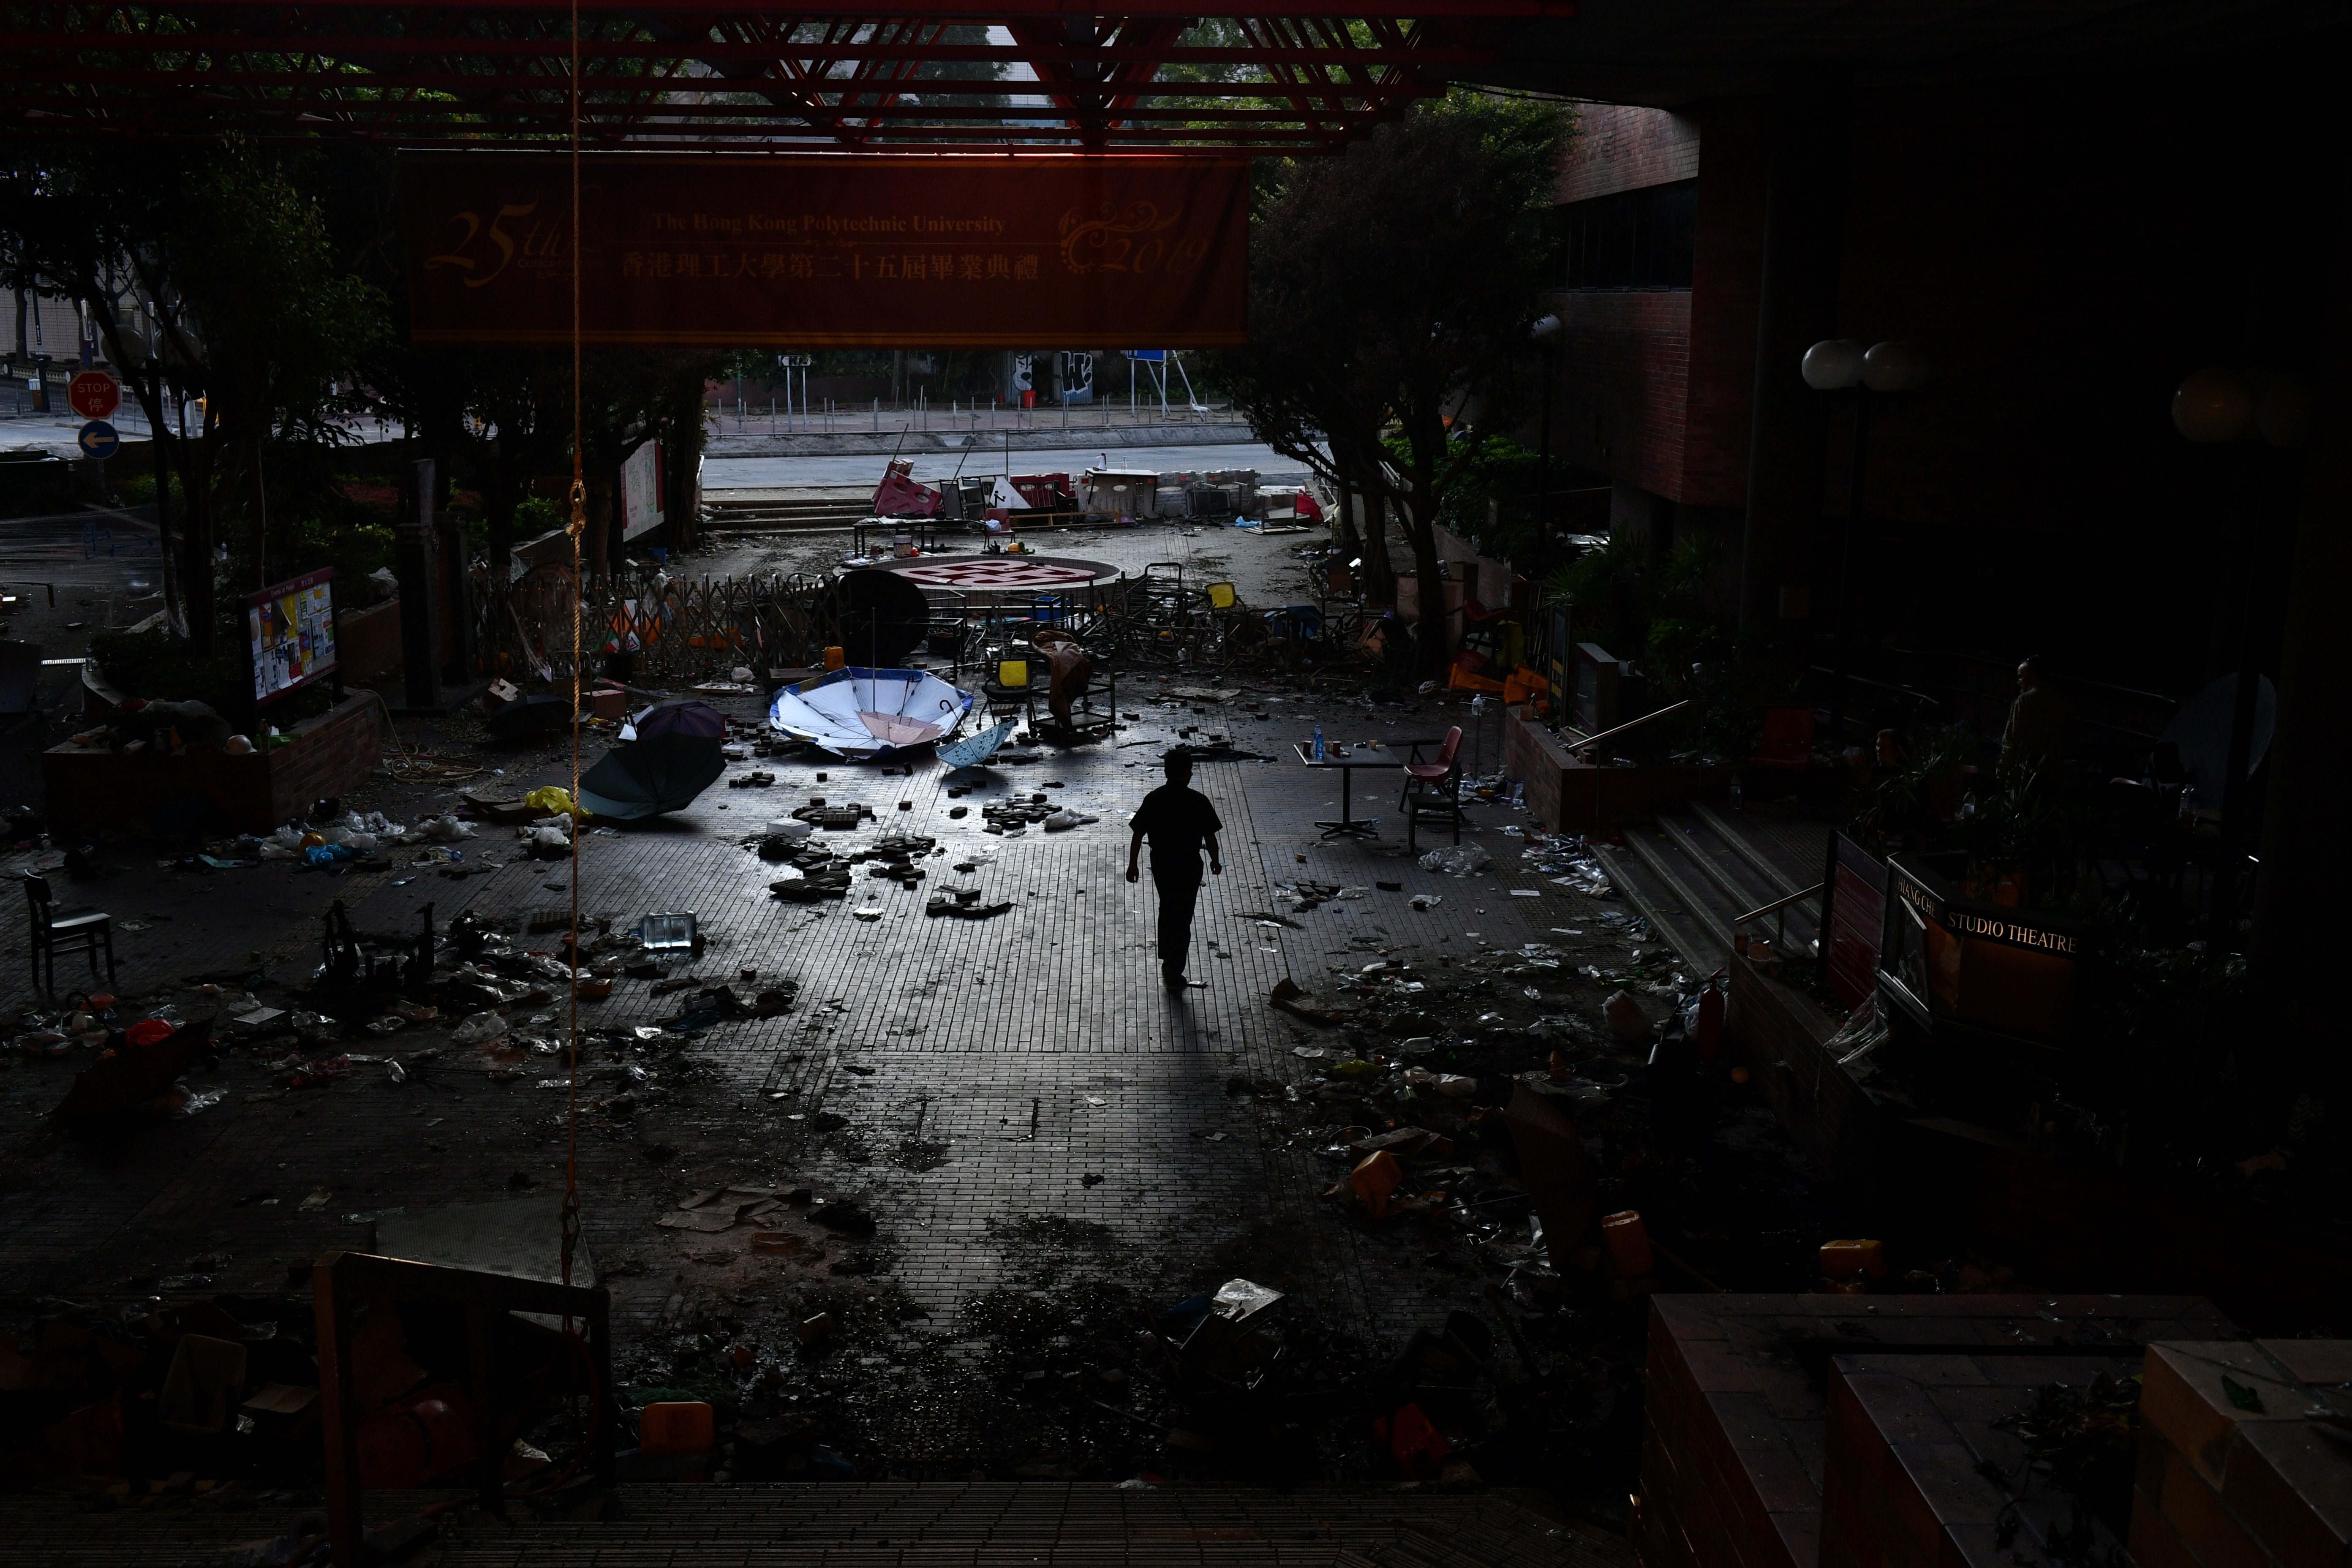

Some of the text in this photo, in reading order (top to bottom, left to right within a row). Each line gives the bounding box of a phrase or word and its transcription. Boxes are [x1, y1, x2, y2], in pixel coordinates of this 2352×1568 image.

[425, 185, 602, 288] 25th
[652, 213, 1006, 236] The Hong Kong Polytechnic University
[620, 251, 1039, 280] 香港理工大學第二十五屆畢業典禮
[1098, 238, 1209, 275] 2019
[77, 383, 110, 393] STOP
[88, 397, 103, 412] 停
[1948, 912, 2077, 953] STUDIO THEATRE
